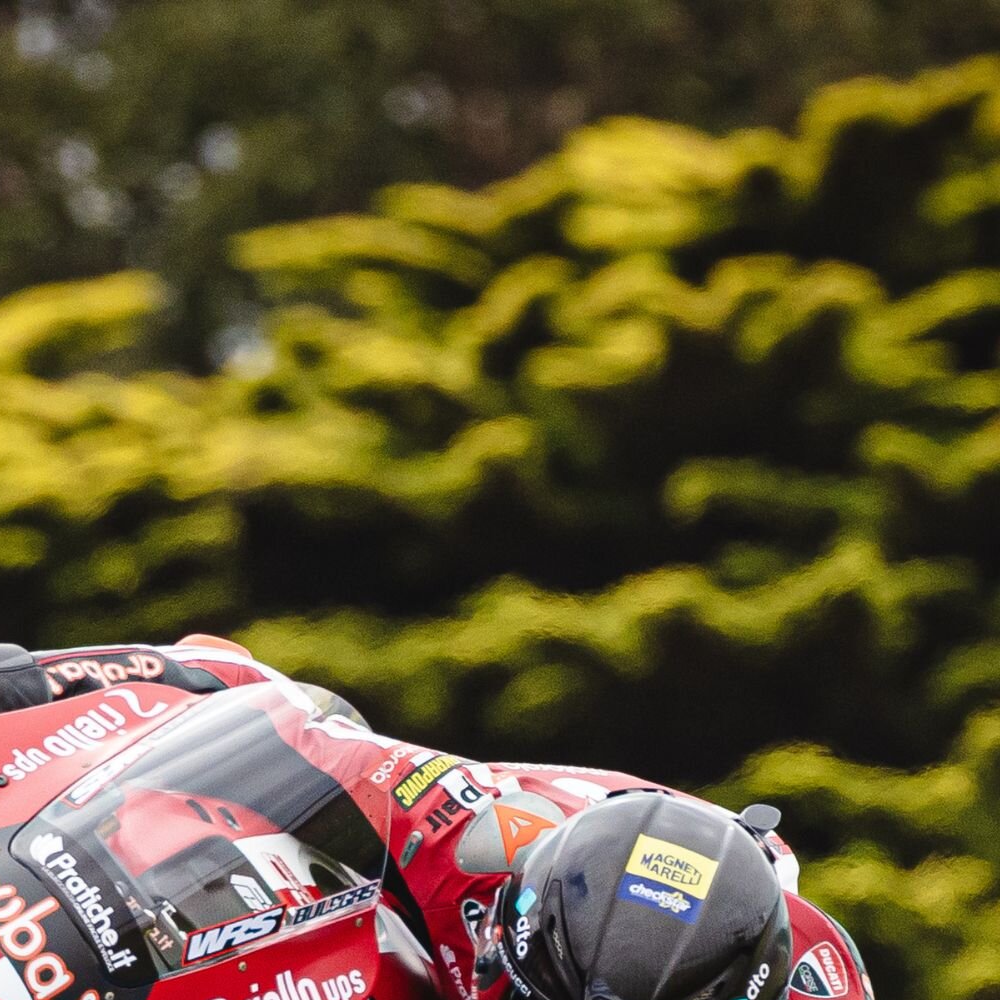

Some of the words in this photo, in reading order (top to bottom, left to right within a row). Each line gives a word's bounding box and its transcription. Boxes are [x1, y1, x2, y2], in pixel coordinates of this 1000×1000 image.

[44, 703, 127, 757] riello
[2, 748, 52, 780] ups
[46, 852, 138, 969] Pratiche.it
[186, 906, 284, 961] WRS
[818, 948, 844, 991] DUCATI
